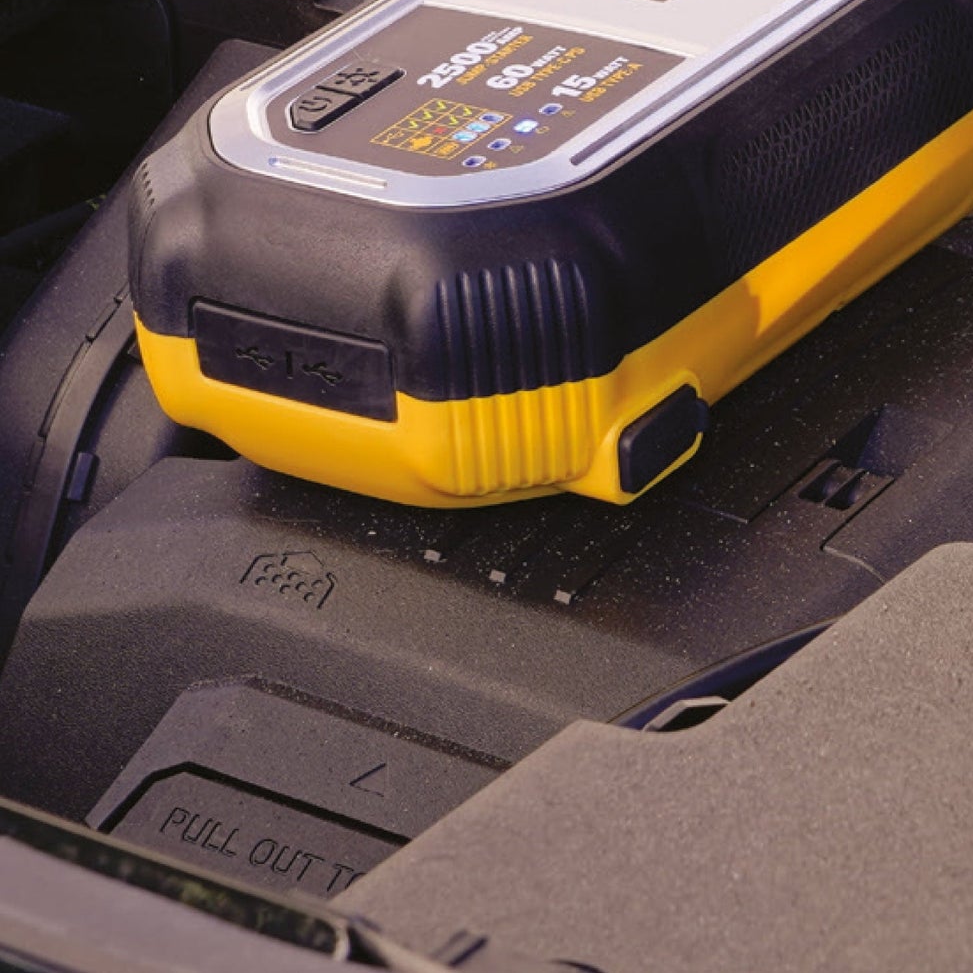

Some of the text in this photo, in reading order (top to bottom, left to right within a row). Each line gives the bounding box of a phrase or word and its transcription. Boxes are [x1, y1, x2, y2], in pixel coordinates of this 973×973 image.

[416, 40, 498, 89] 2500
[486, 45, 567, 90] 60 WATT
[551, 55, 631, 98] 15 WATT
[508, 80, 537, 98] USB
[579, 85, 608, 103] USB
[159, 806, 241, 858] PULL
[248, 838, 325, 883] OUT
